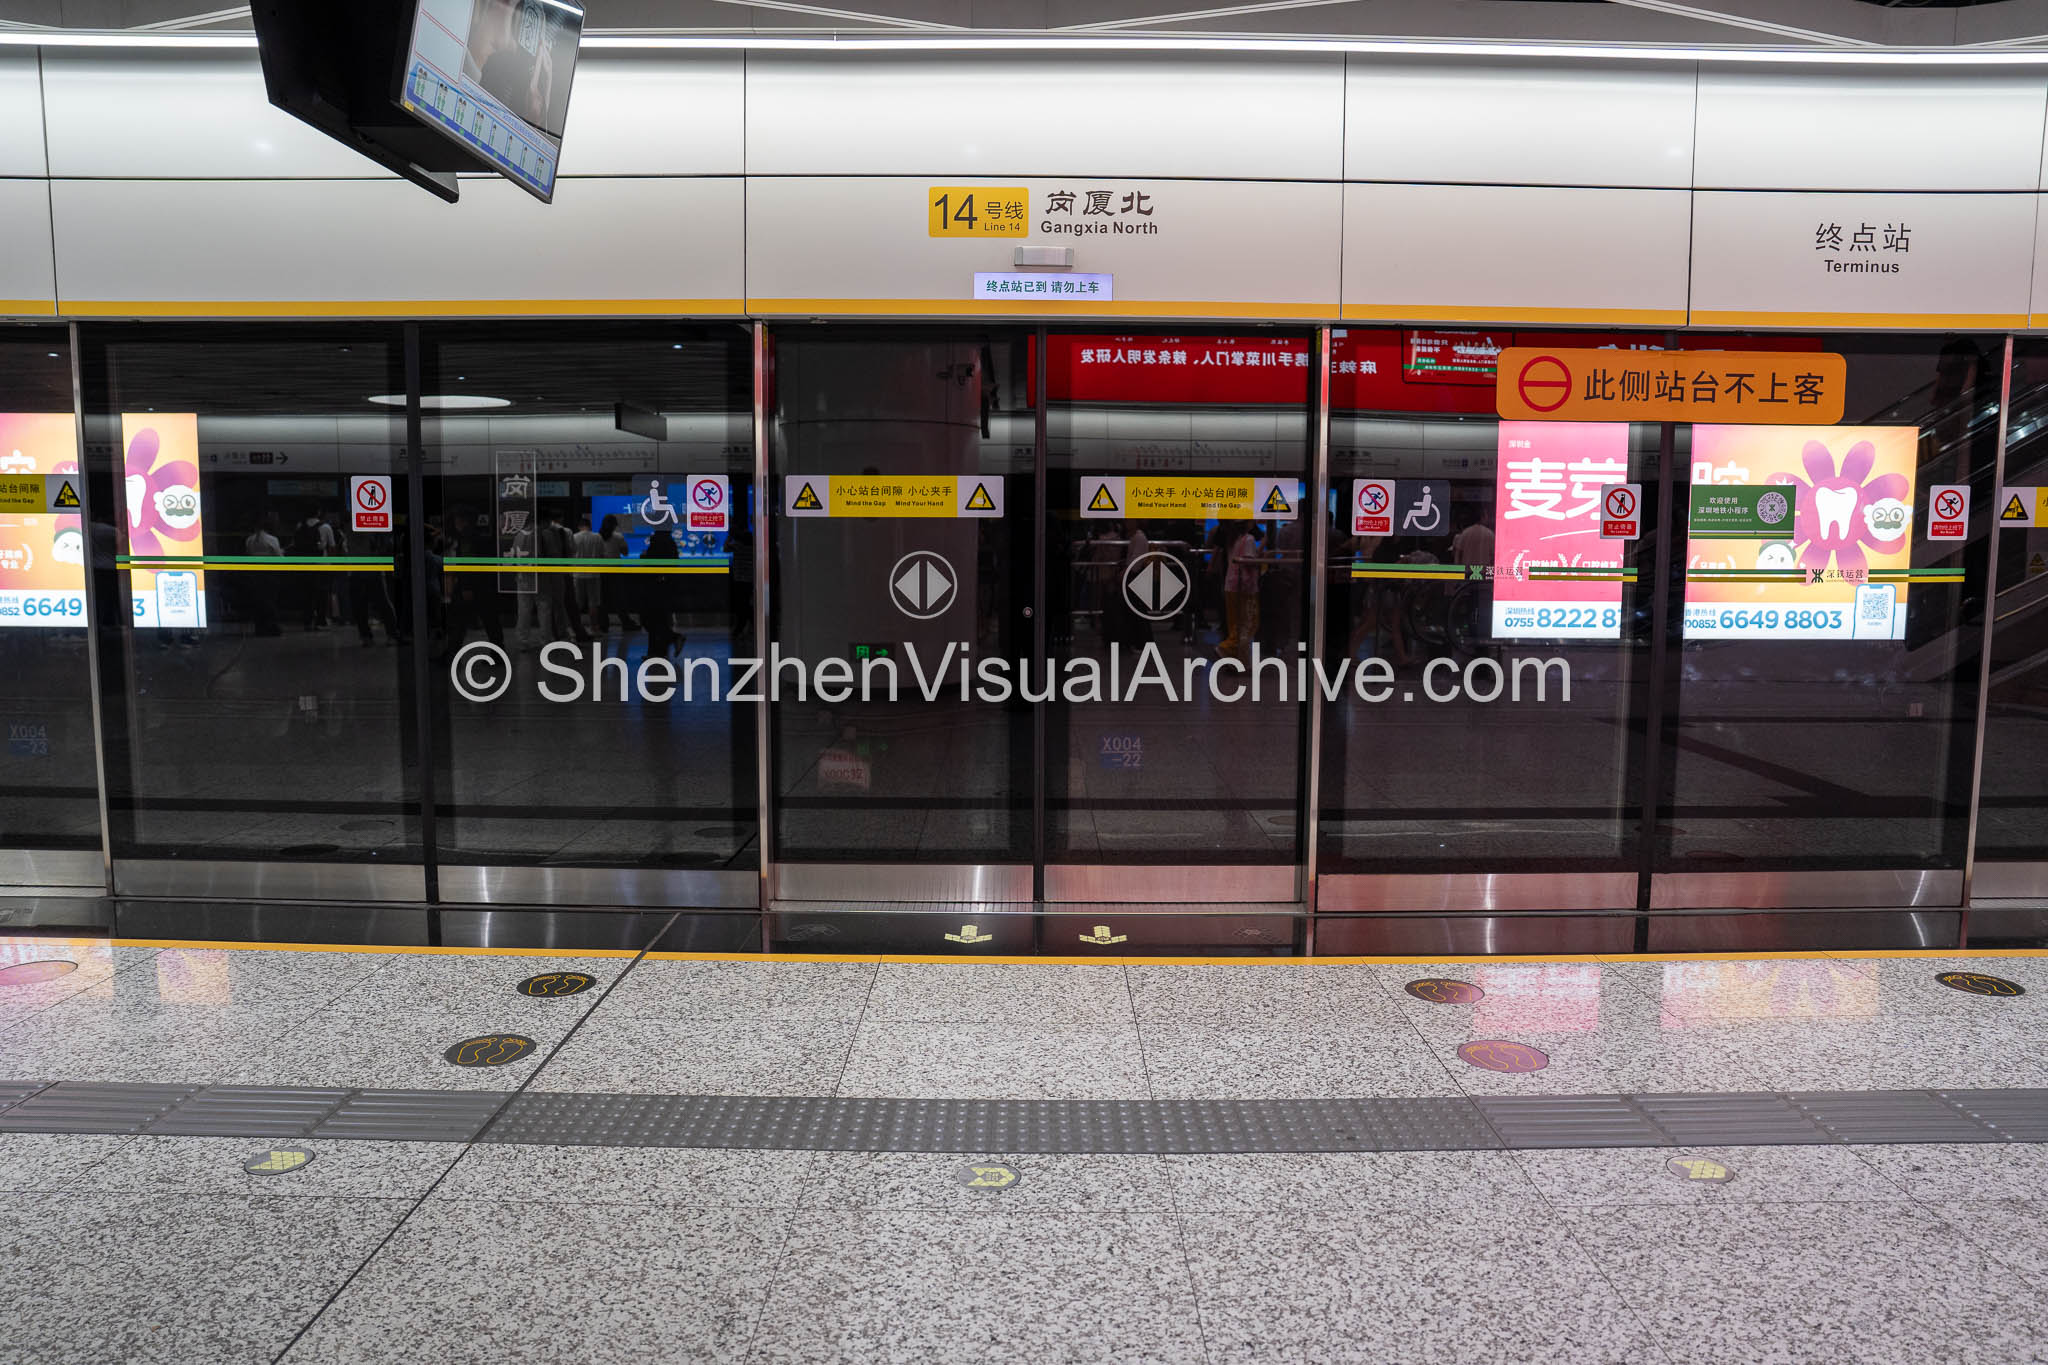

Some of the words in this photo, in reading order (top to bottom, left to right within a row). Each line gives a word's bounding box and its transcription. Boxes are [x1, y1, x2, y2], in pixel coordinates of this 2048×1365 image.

[934, 193, 978, 230] 14
[984, 201, 1024, 220] 号线
[1045, 190, 1154, 217] 岗厦北
[984, 222, 1006, 232] Line
[1008, 222, 1021, 232] 14
[1040, 220, 1108, 237] Gangxia
[1113, 221, 1158, 235] North
[1815, 222, 1912, 253] 终点站
[1824, 259, 1900, 273] Terminus
[986, 280, 1047, 293] 终点站已到
[1050, 280, 1100, 294] 请勿上车
[1583, 368, 1825, 405] 此侧站台不上客
[836, 485, 903, 497] 小心站台间隙
[908, 486, 953, 497] 小心夹手
[1132, 487, 1176, 498] 小心夹手
[1181, 488, 1248, 499] 小心站台间隙
[23, 598, 82, 616] 6649
[1504, 617, 1534, 628] 0755
[1536, 608, 1597, 628] 8222
[1602, 608, 1621, 628] 8
[1720, 610, 1779, 629] 6649
[1784, 610, 1842, 629] 8803
[1102, 736, 1142, 750] X004
